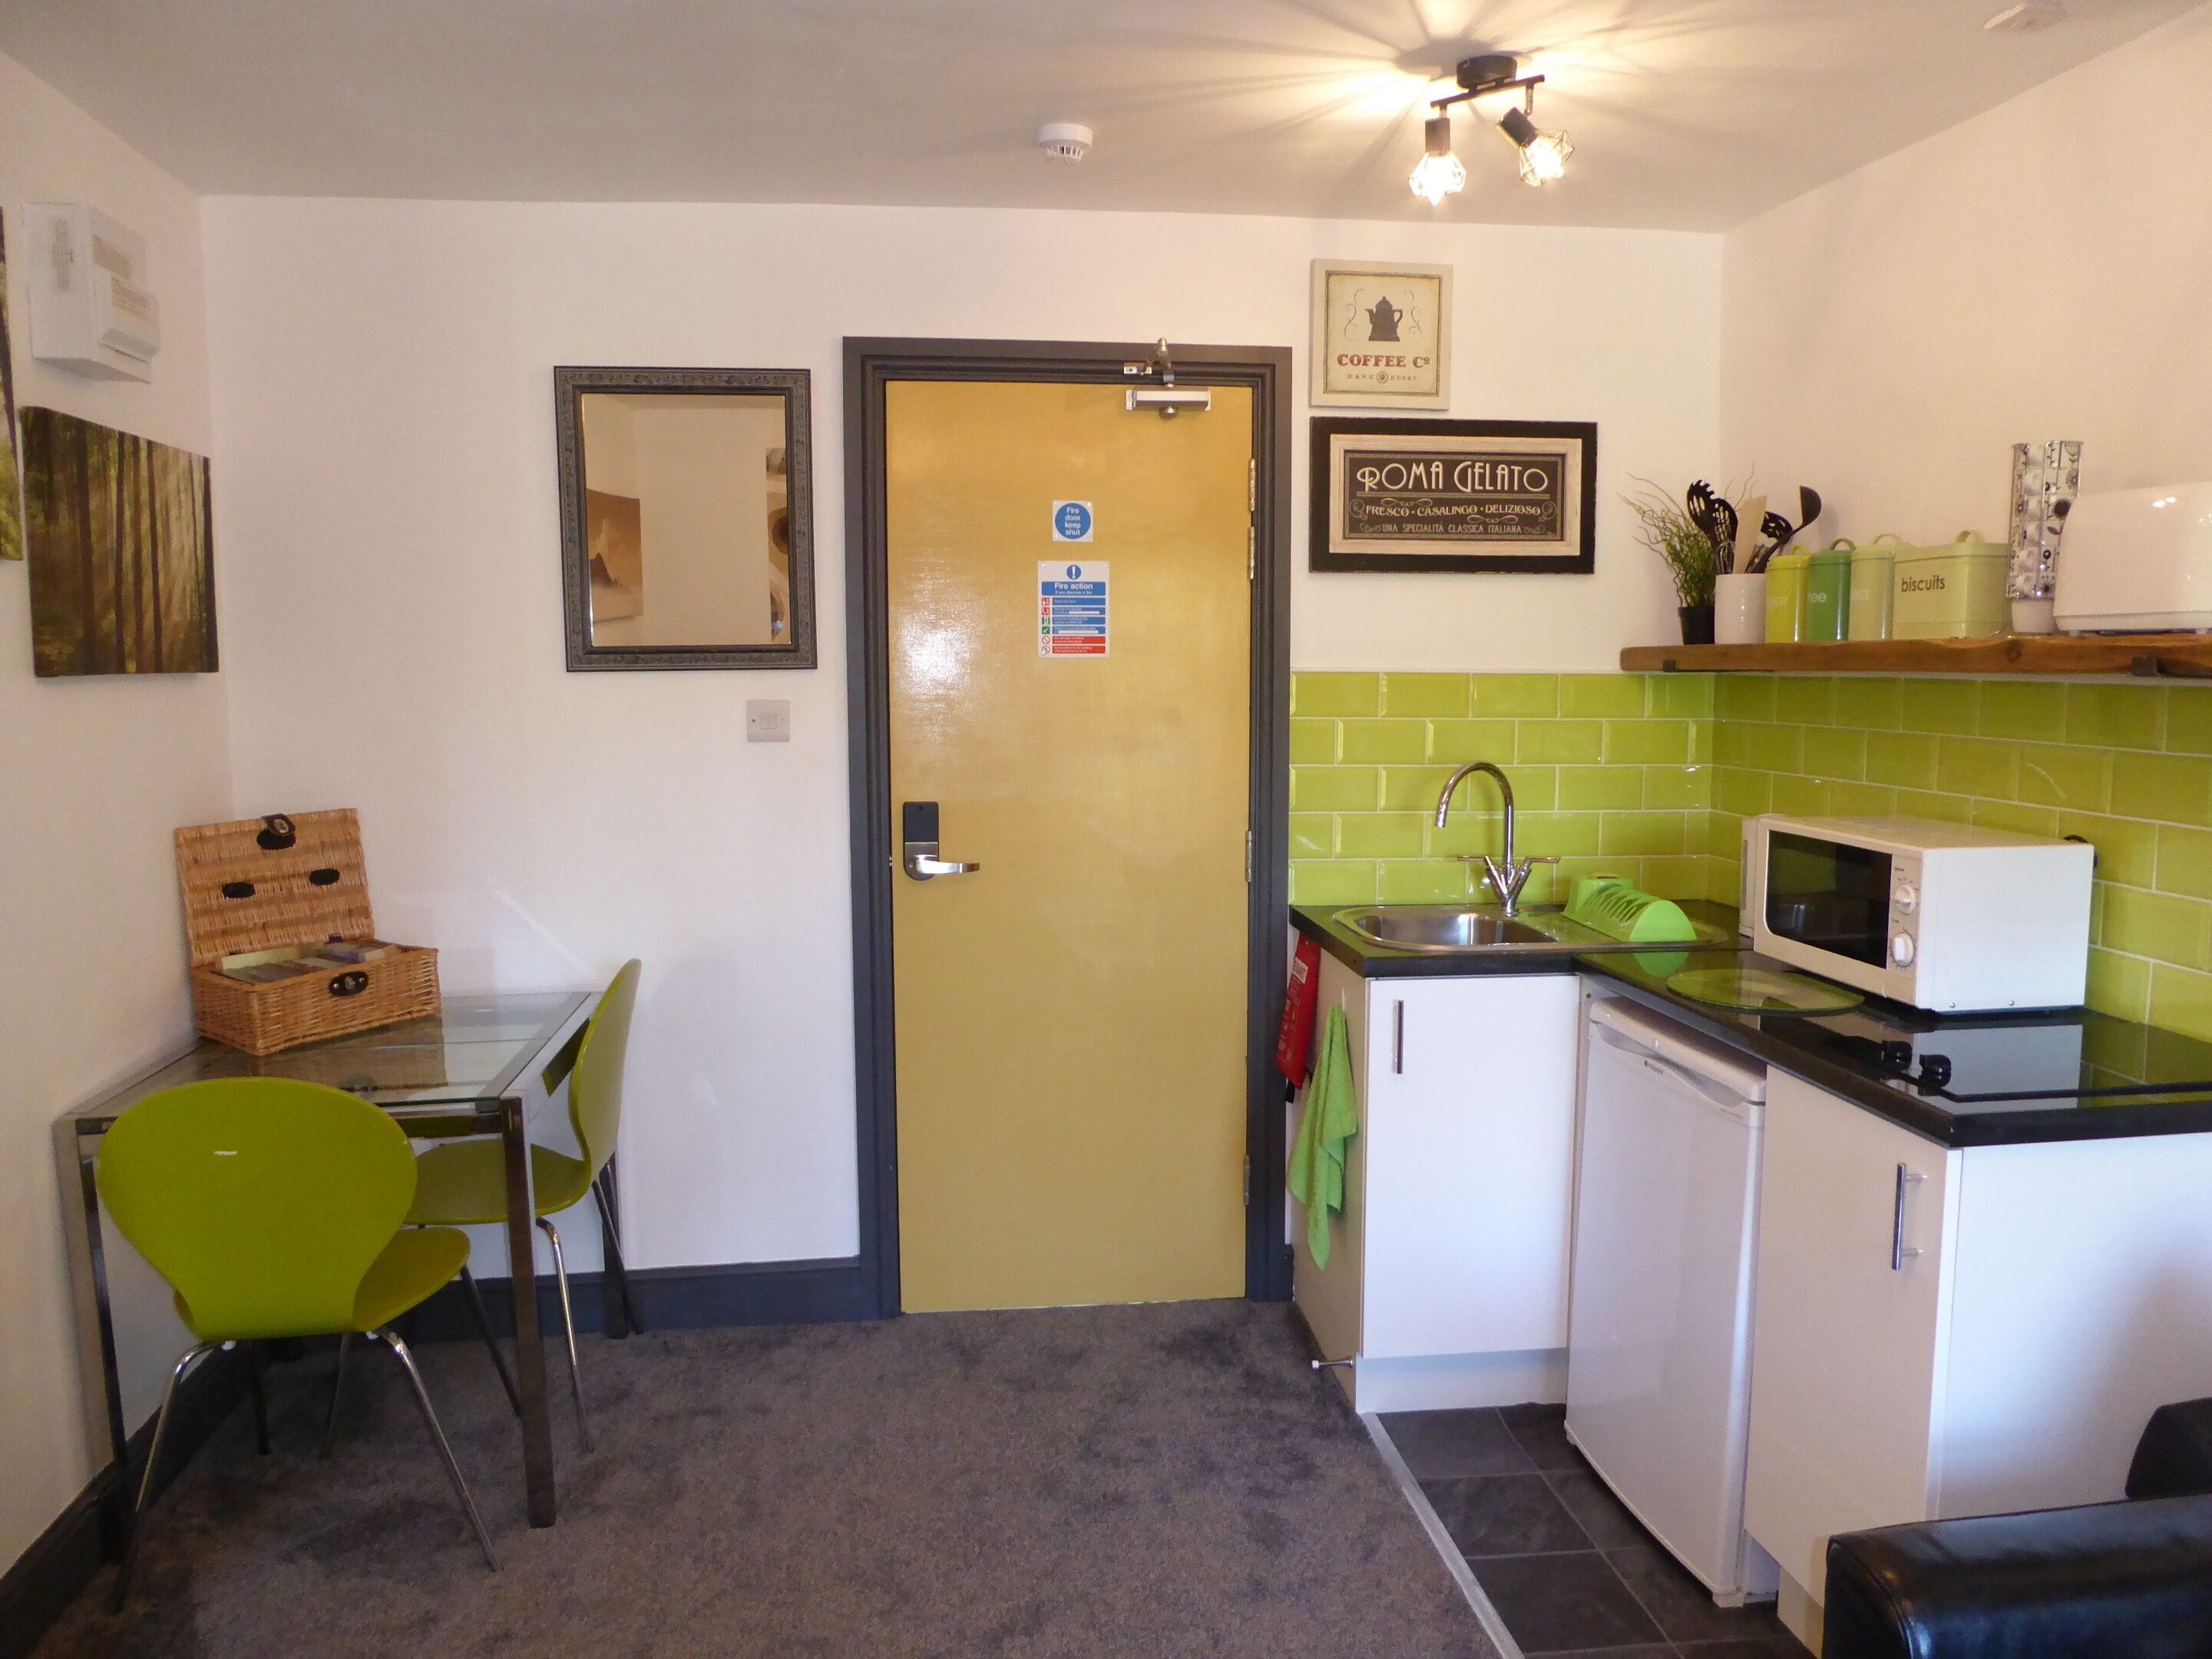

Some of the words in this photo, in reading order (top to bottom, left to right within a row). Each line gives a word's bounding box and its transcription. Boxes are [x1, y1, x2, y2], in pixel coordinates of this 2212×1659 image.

[1337, 354, 1406, 367] COFFEE
[1357, 461, 1443, 491] ROMA
[1454, 461, 1548, 492] GELATO
[1367, 505, 1409, 517] FRESCO
[1417, 504, 1478, 517] CASALINGO
[1485, 504, 1541, 516] DELIZIOSO
[1383, 524, 1397, 532] UNA
[1448, 524, 1483, 533] CLASSICA
[1488, 524, 1522, 534] ITALIANA
[1901, 574, 1946, 592] biscuits
